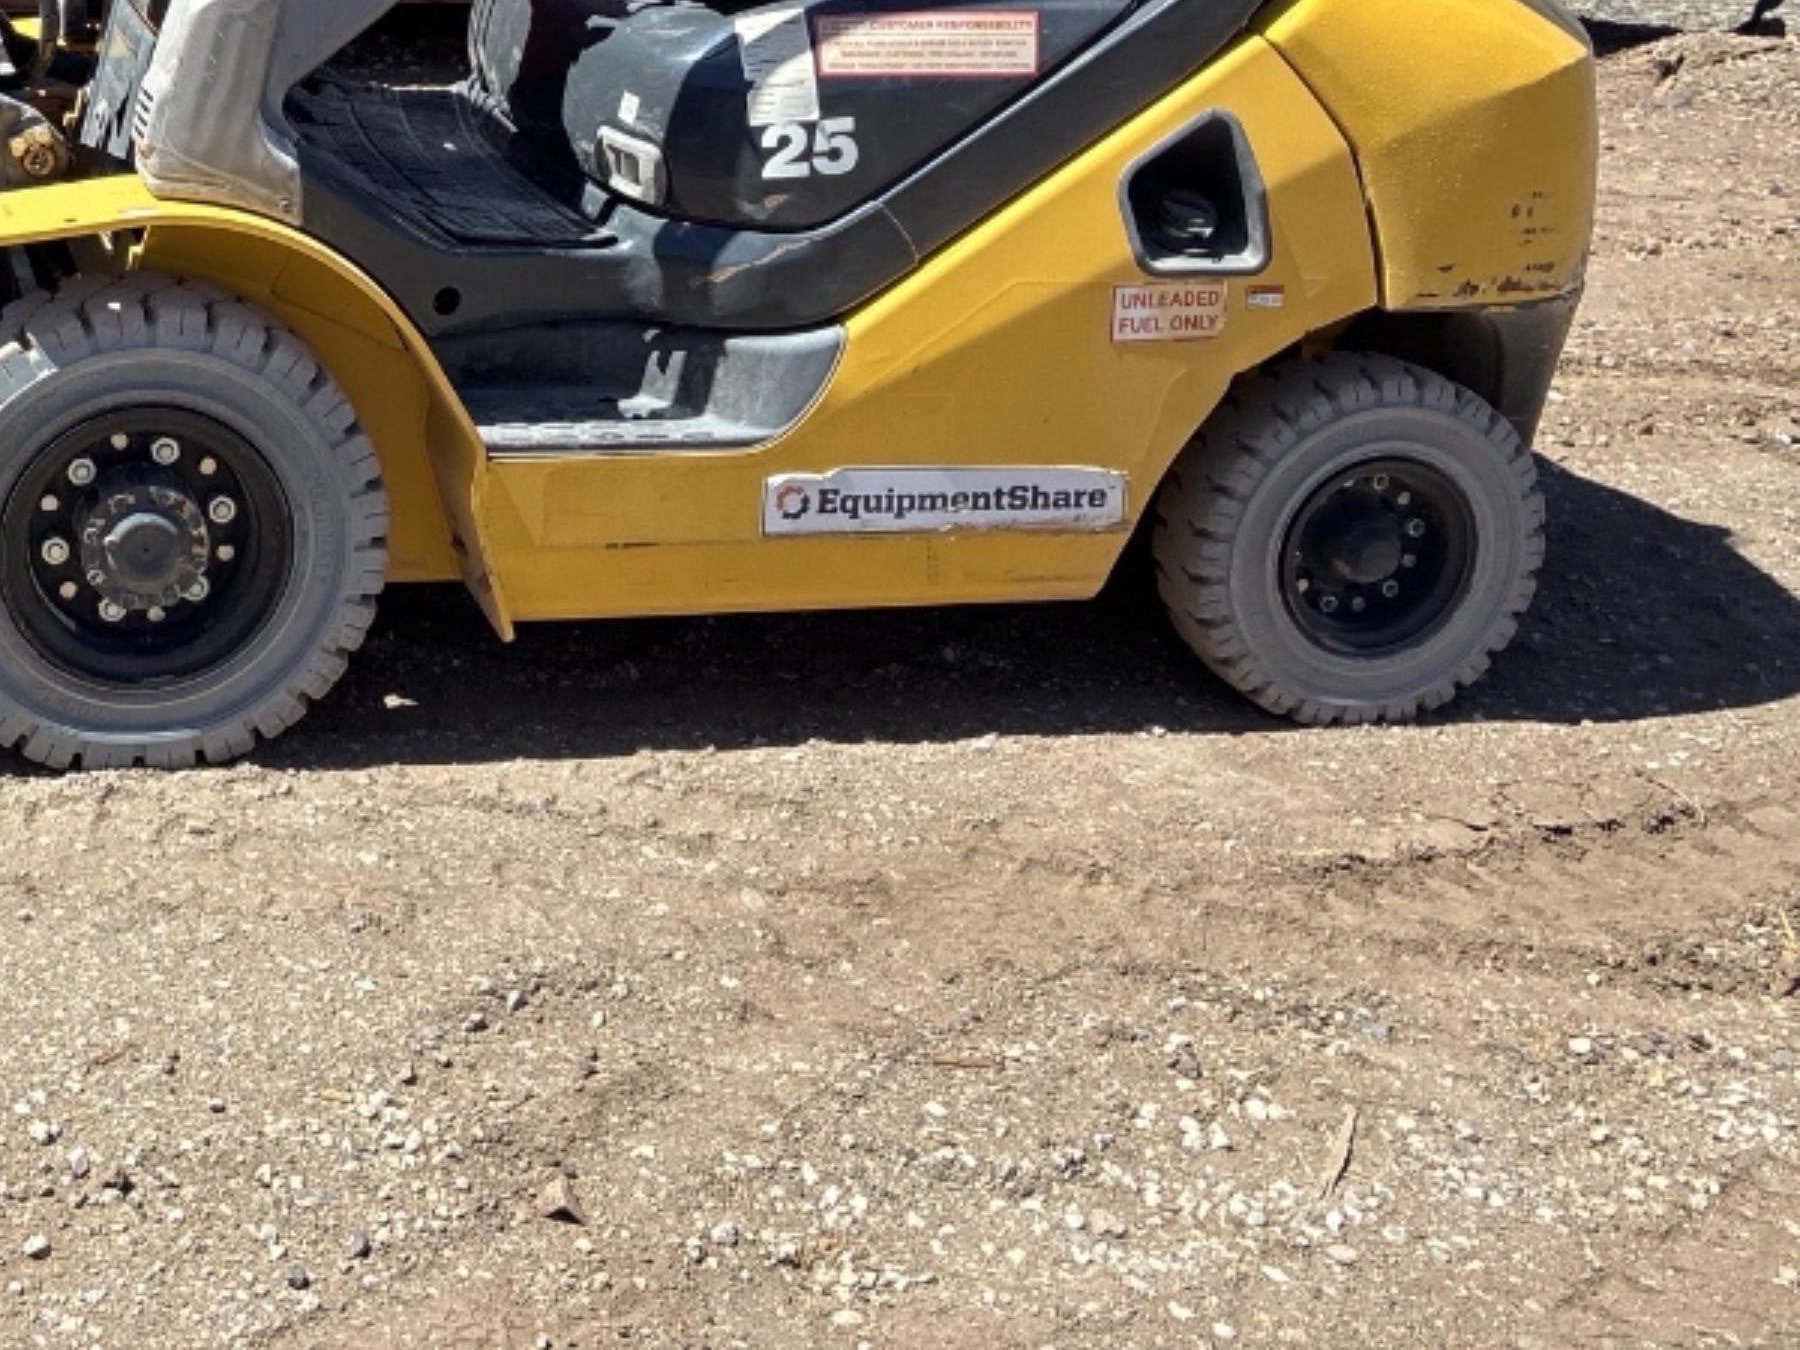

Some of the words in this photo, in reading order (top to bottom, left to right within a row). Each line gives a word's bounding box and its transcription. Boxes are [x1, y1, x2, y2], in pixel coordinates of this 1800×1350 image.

[761, 116, 860, 180] 25
[1120, 290, 1220, 310] UNLEADED
[1118, 317, 1162, 334] FUEL
[1169, 314, 1218, 331] ONLY
[816, 484, 1107, 519] EquipmentShare
